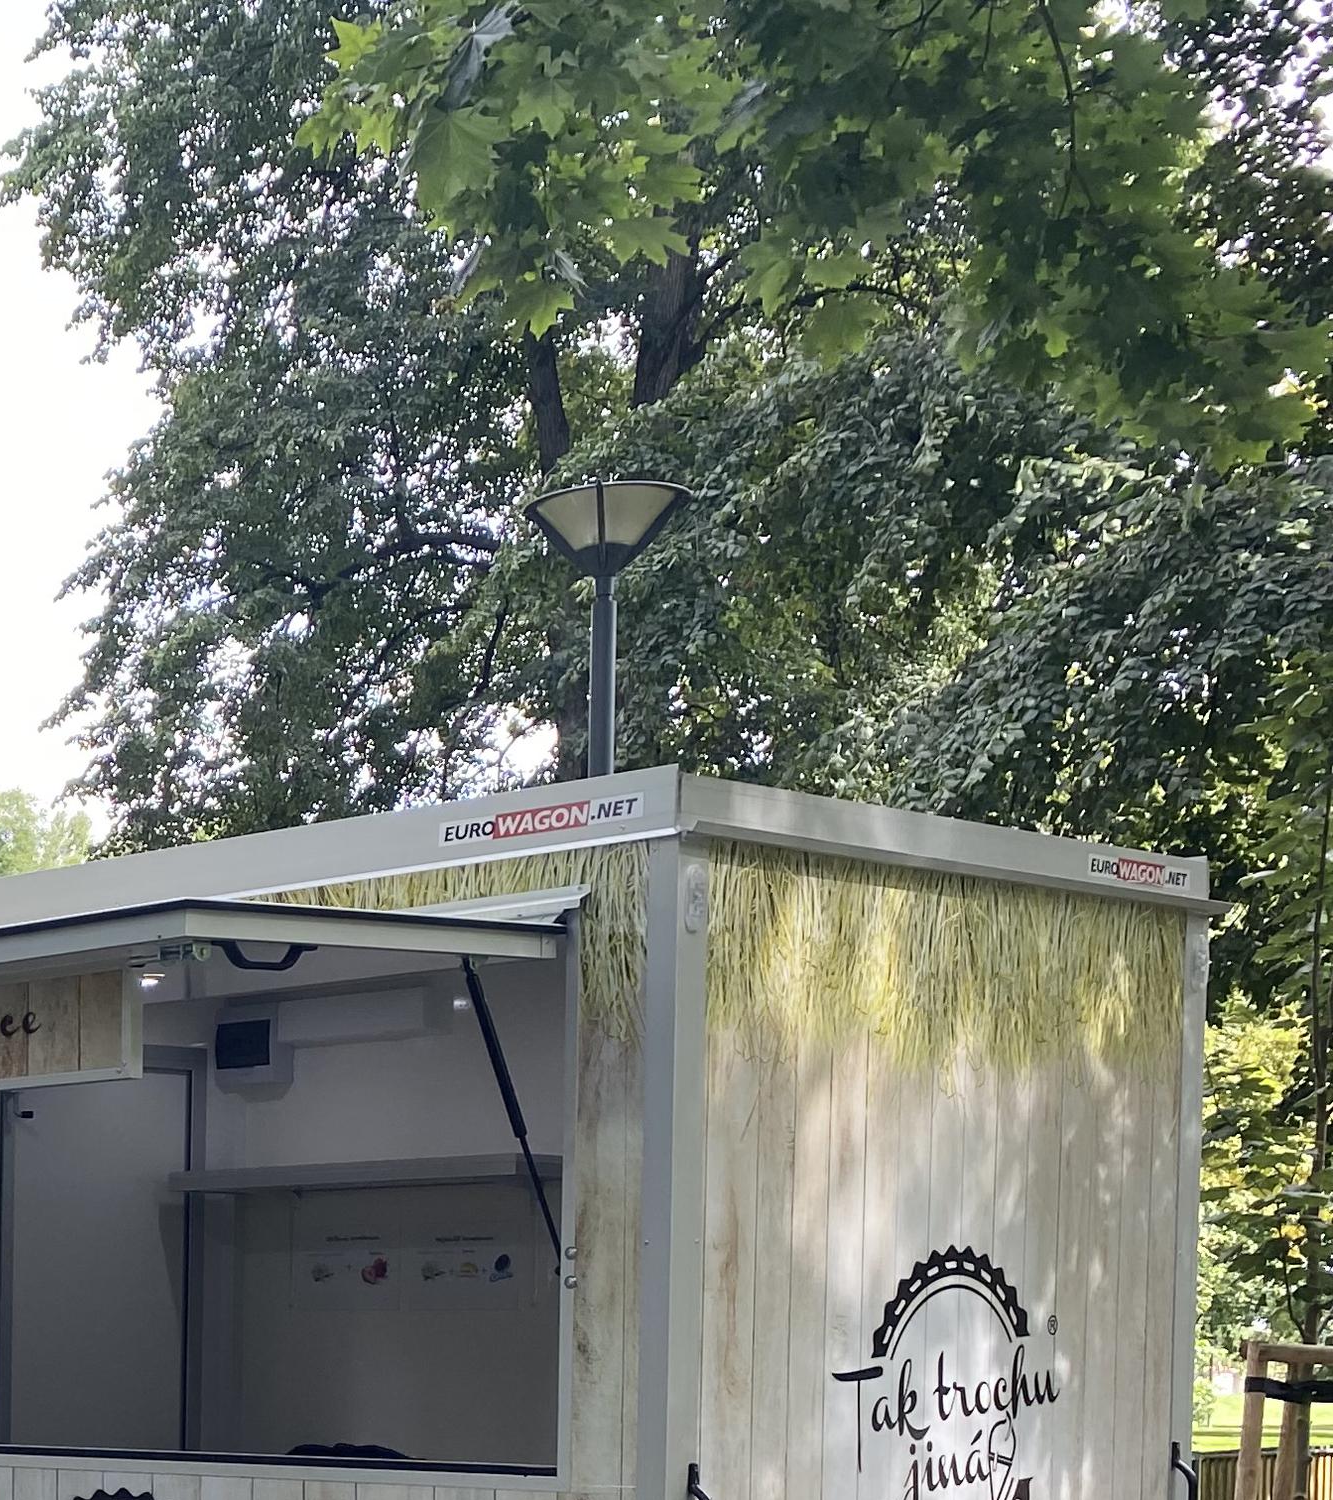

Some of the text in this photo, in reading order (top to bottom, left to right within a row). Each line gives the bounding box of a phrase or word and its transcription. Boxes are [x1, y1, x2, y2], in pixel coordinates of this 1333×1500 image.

[444, 798, 638, 842] EUROWAGON.NET
[1090, 858, 1188, 887] EUROWAGON.NET
[832, 1344, 1061, 1474] Tak trochu
